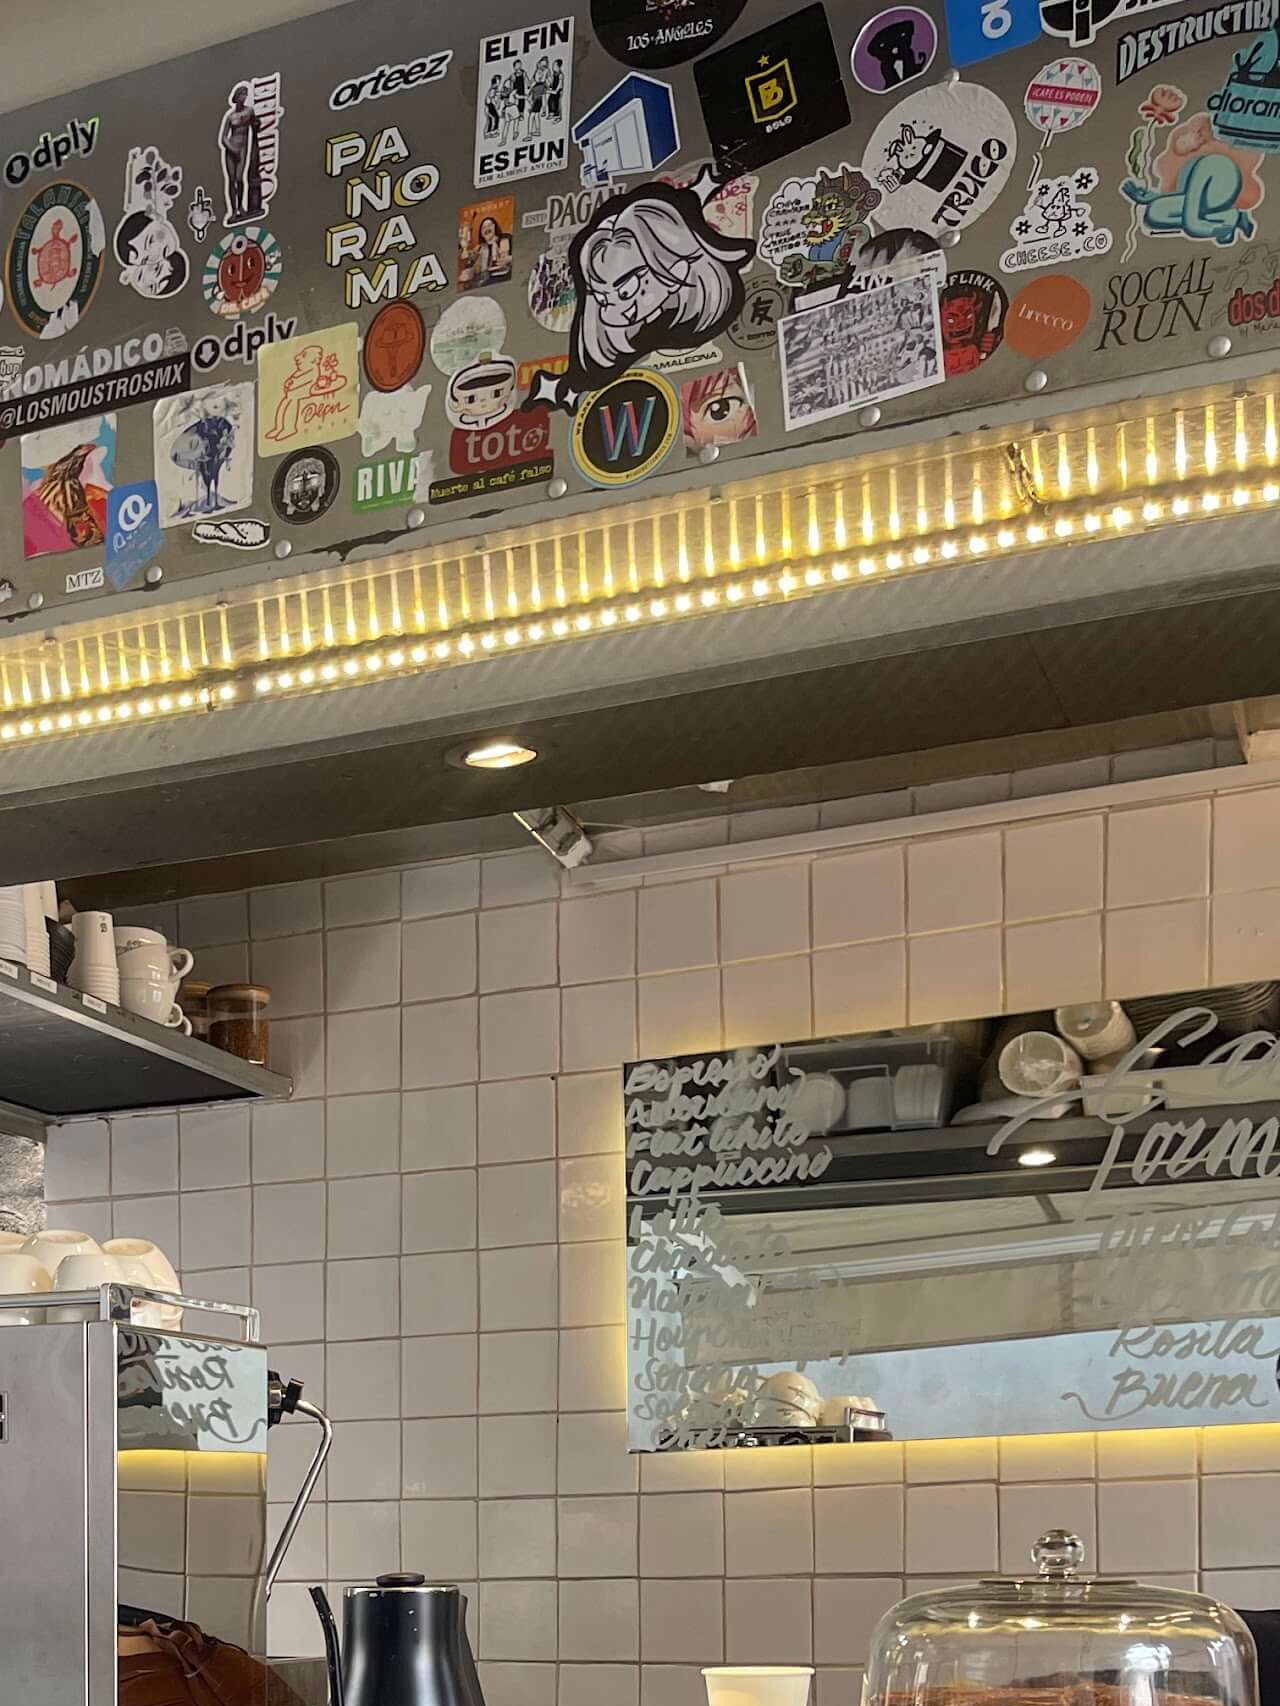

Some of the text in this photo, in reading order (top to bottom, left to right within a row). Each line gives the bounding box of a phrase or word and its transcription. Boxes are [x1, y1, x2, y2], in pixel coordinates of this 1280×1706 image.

[485, 19, 570, 63] EL FIN
[333, 53, 449, 108] orteez
[34, 120, 97, 167] dply
[326, 126, 410, 177] PA
[479, 138, 565, 176] ES FUN
[345, 164, 440, 218] NO
[326, 215, 417, 267] RA
[345, 253, 448, 309] MA
[1103, 257, 1214, 310] SOCIAL
[225, 316, 294, 366] dply
[1096, 292, 1212, 351] RUN
[0, 361, 185, 430] @LOSMOUSTROSMX
[474, 478, 487, 491] al
[69, 572, 102, 590] MTZ
